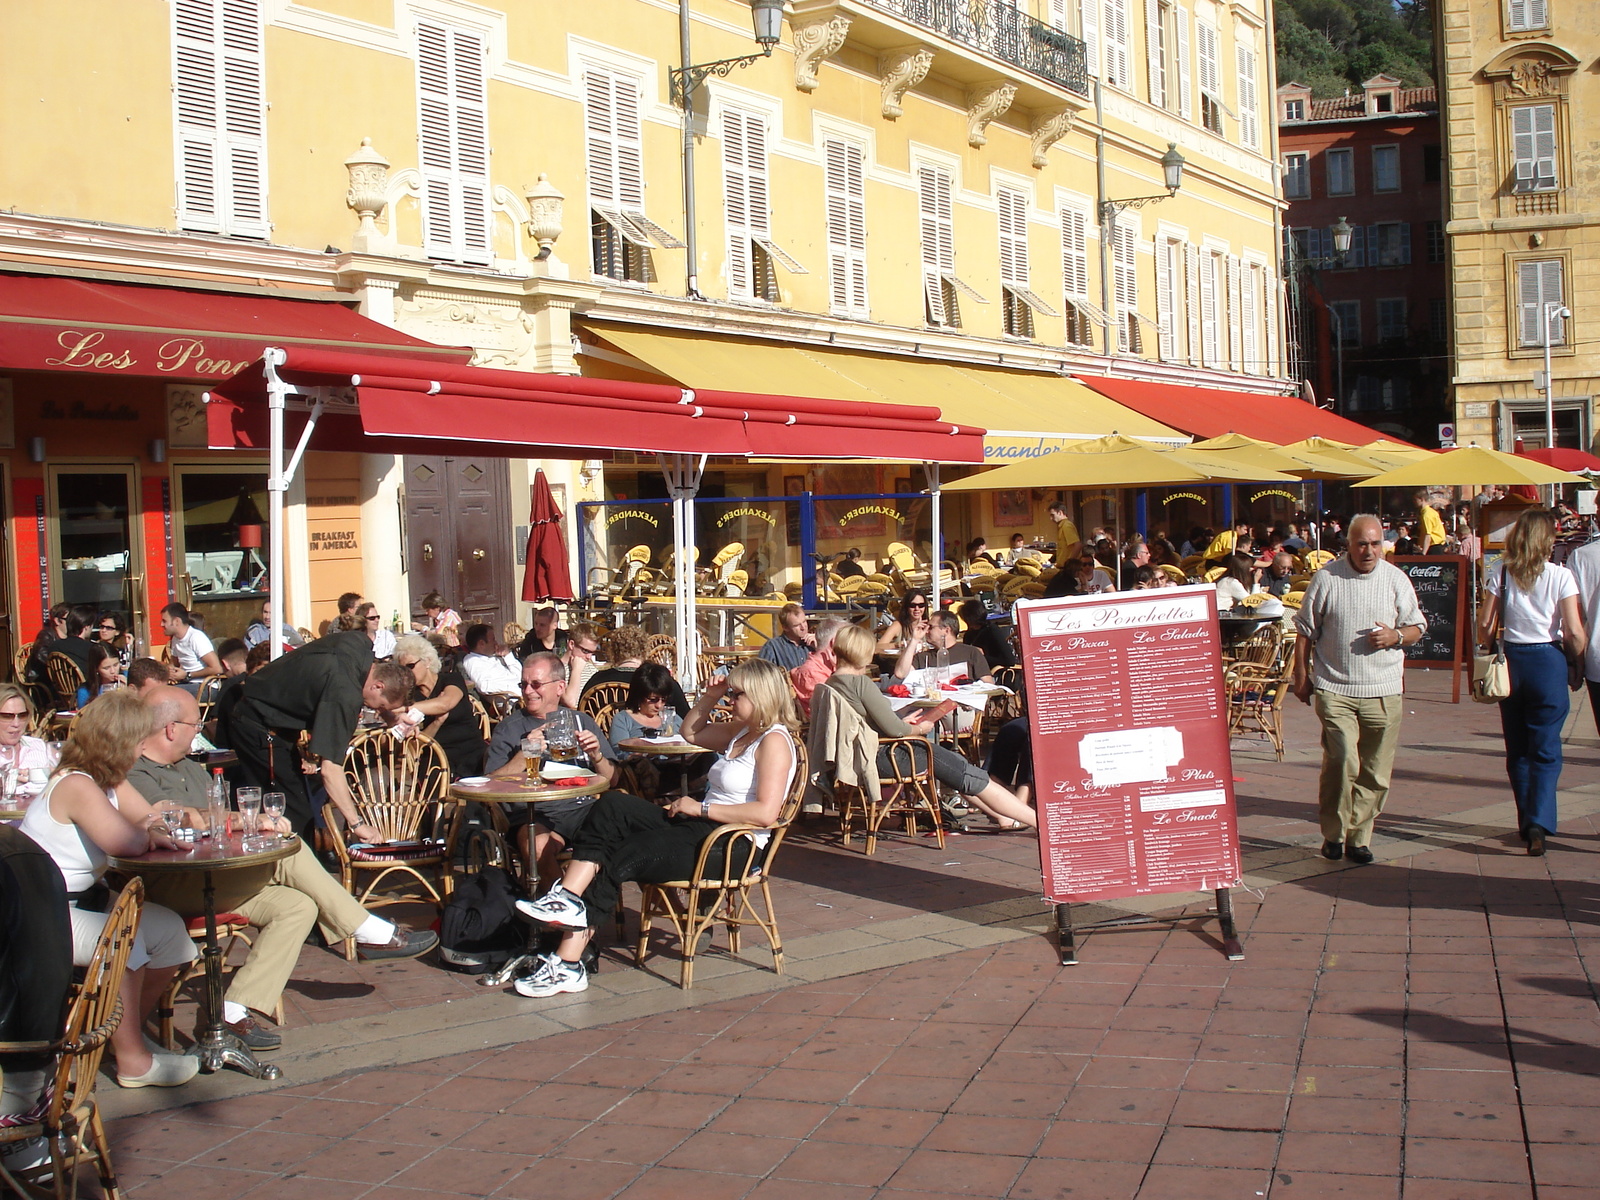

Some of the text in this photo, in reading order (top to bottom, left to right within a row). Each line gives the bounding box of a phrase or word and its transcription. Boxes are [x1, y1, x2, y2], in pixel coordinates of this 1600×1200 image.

[45, 330, 138, 370] Les
[1162, 492, 1208, 506] ALEXANDER'S
[1249, 489, 1298, 504] ALEXANDER'S
[311, 531, 355, 541] BREAKFAST
[309, 540, 358, 551] IN AMERICA
[1045, 606, 1196, 632] Les Ponchettes
[1132, 627, 1210, 644] Les Salades
[1039, 636, 1110, 652] Les Pizzas
[1181, 768, 1215, 782] Plats
[1052, 780, 1076, 793] Les
[1152, 809, 1218, 825] Le Snack
